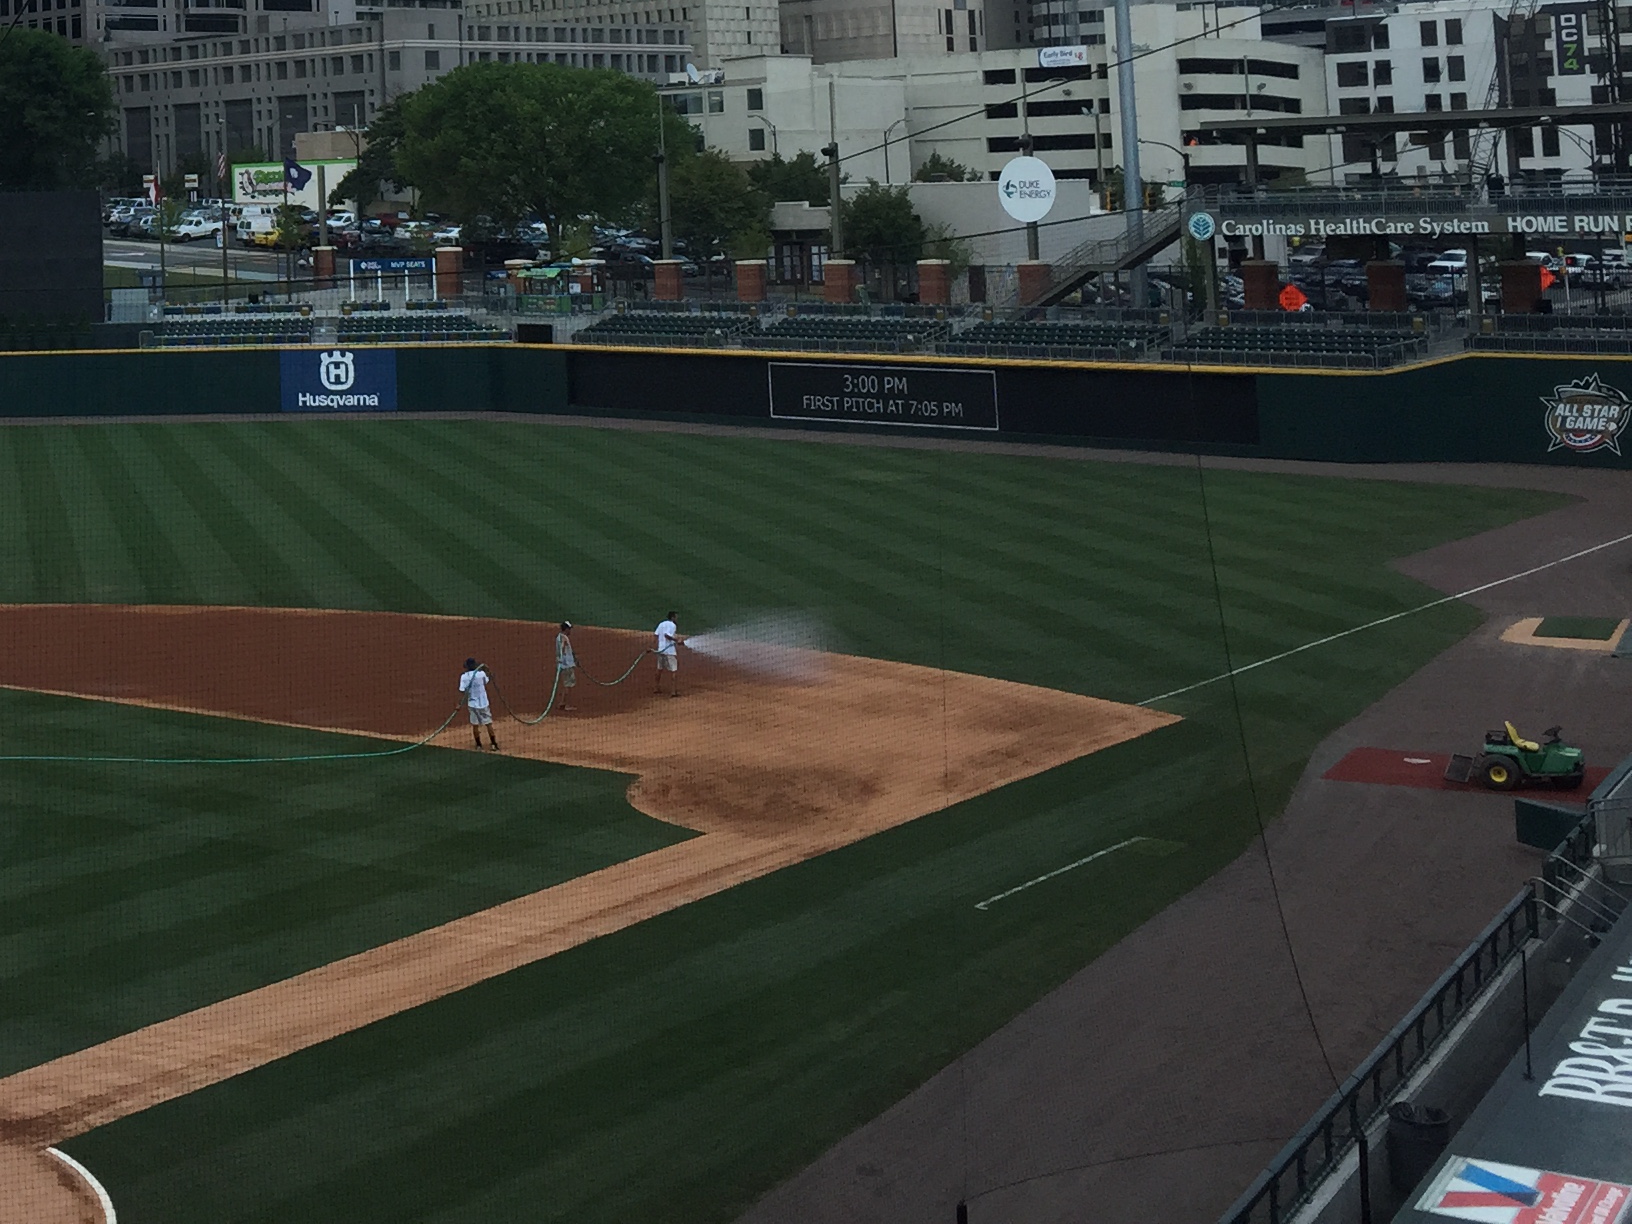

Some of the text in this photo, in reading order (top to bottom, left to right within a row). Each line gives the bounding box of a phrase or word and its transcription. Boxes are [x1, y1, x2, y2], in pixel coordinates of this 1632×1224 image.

[1018, 180, 1040, 189] DUKE
[1019, 190, 1051, 199] ENERGY
[1221, 219, 1305, 236] Carolinas
[1308, 219, 1415, 235] HealthCare
[1419, 217, 1490, 239] System
[1507, 216, 1569, 233] HOME
[1574, 215, 1620, 233] RUN
[406, 260, 426, 268] SEATS
[843, 374, 909, 395] 3:00 PM
[298, 392, 379, 409] Husqvarna
[802, 395, 964, 418] FIRST PITCH AT 7:05 PM
[1554, 403, 1620, 418] ALL STAR
[1565, 417, 1608, 430] GAME
